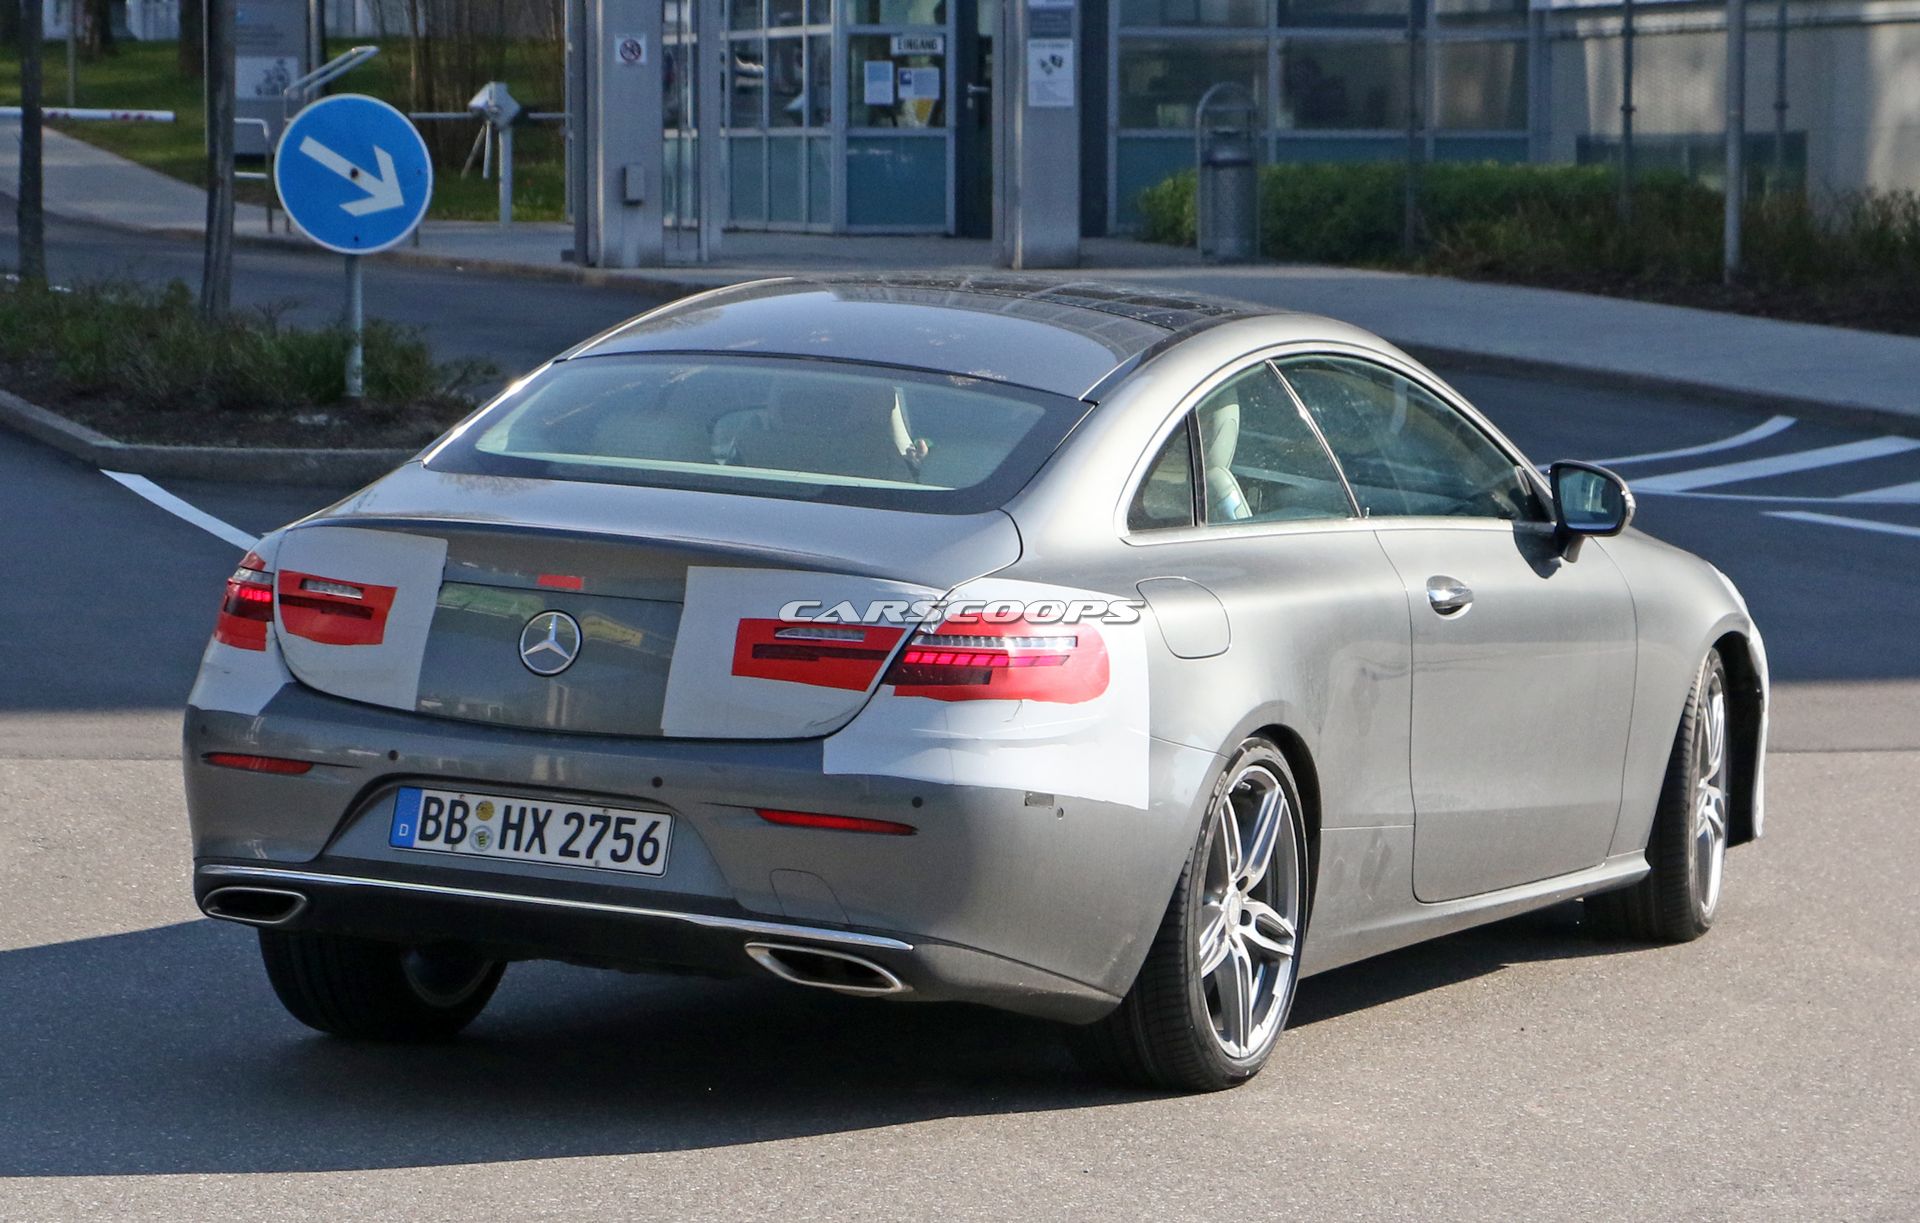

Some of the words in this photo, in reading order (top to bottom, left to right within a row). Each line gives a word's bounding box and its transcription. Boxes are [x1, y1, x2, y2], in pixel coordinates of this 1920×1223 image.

[897, 38, 938, 50] EINGANG
[399, 823, 409, 836] D
[418, 796, 470, 845] BB
[499, 804, 553, 855] HX
[558, 811, 661, 866] 2756
